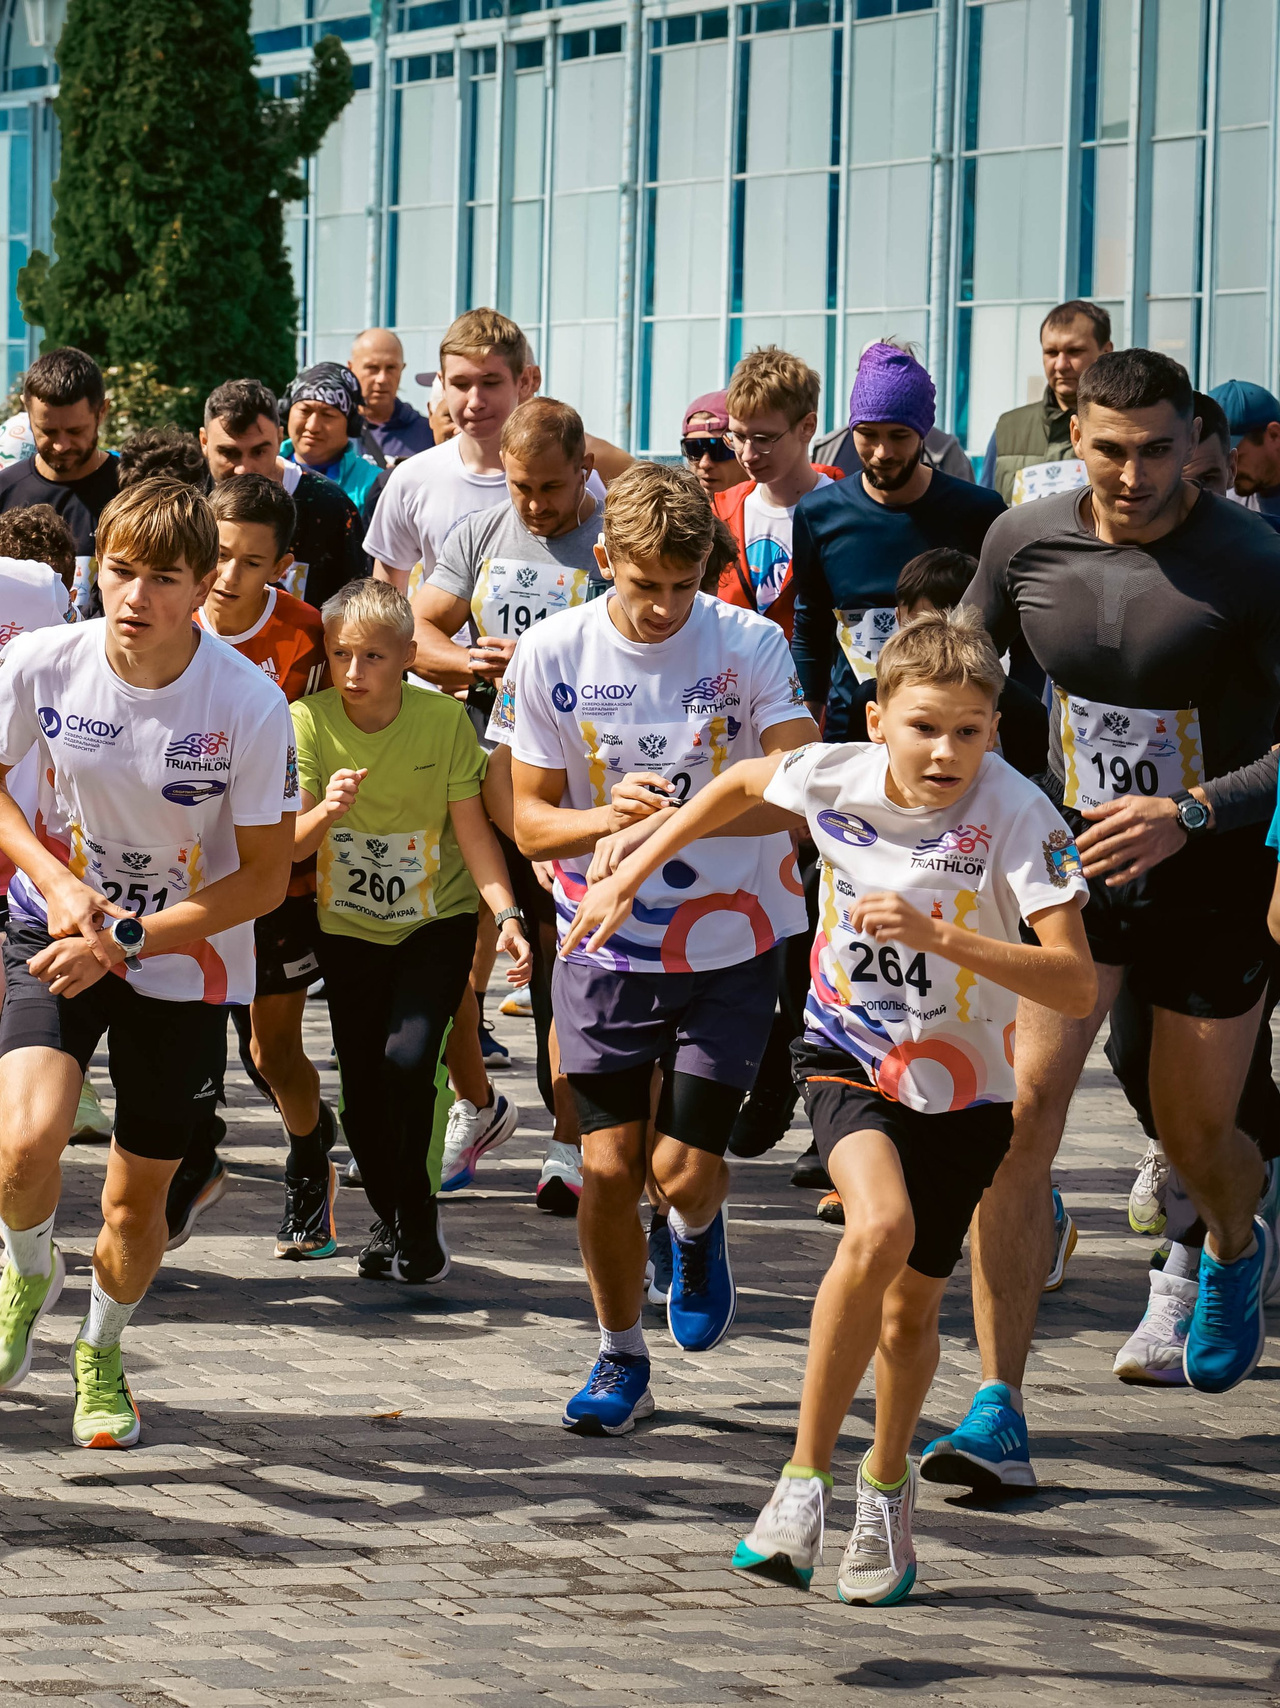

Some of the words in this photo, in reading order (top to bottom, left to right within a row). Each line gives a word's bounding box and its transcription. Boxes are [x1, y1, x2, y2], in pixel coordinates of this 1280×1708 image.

[581, 684, 638, 700] СКФУ
[66, 714, 125, 739] СКФУ
[164, 757, 232, 772] TRIATHLON
[1090, 752, 1159, 796] 190
[910, 857, 985, 876] TRIATHLON
[944, 853, 987, 865] STAVROPO
[347, 868, 406, 906] 260
[101, 881, 169, 919] 251
[334, 899, 396, 920] СТАВРОПОЛЬСКИЙ
[397, 906, 416, 919] КРАЙ
[848, 941, 932, 997] 264
[861, 1000, 922, 1020] РОПОЛЬСКИЙ
[923, 1004, 947, 1021] КРАЙ
